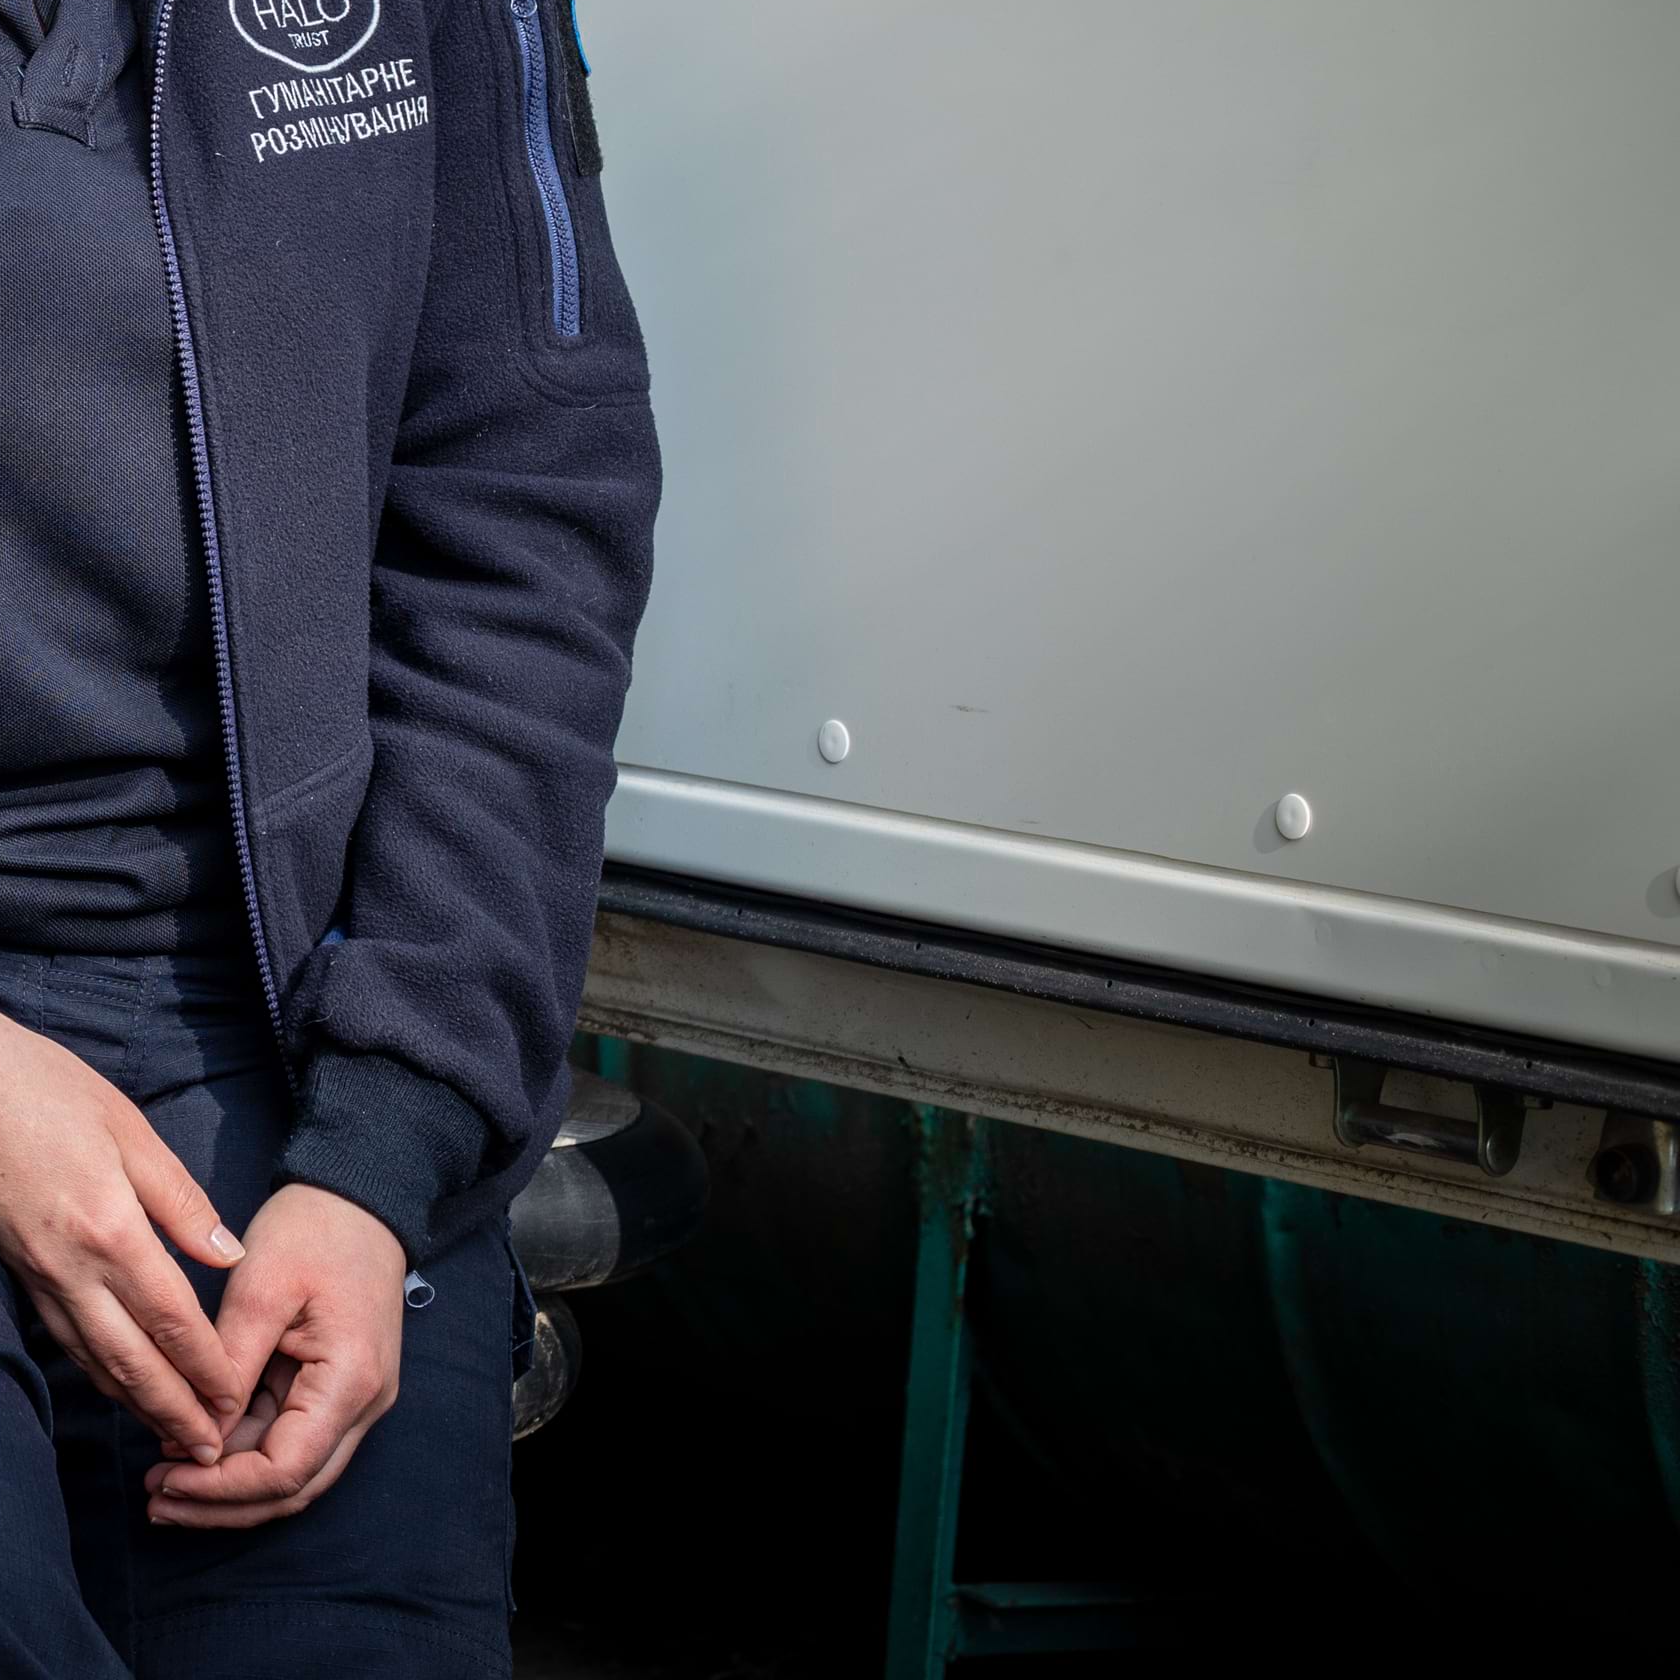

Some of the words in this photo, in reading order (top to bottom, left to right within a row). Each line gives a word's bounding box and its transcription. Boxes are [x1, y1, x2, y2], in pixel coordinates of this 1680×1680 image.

[288, 30, 329, 49] TRUST
[248, 59, 416, 119] ГУМАНІТАРНЕ
[250, 96, 428, 163] РОЗМІНУВАННЯ
